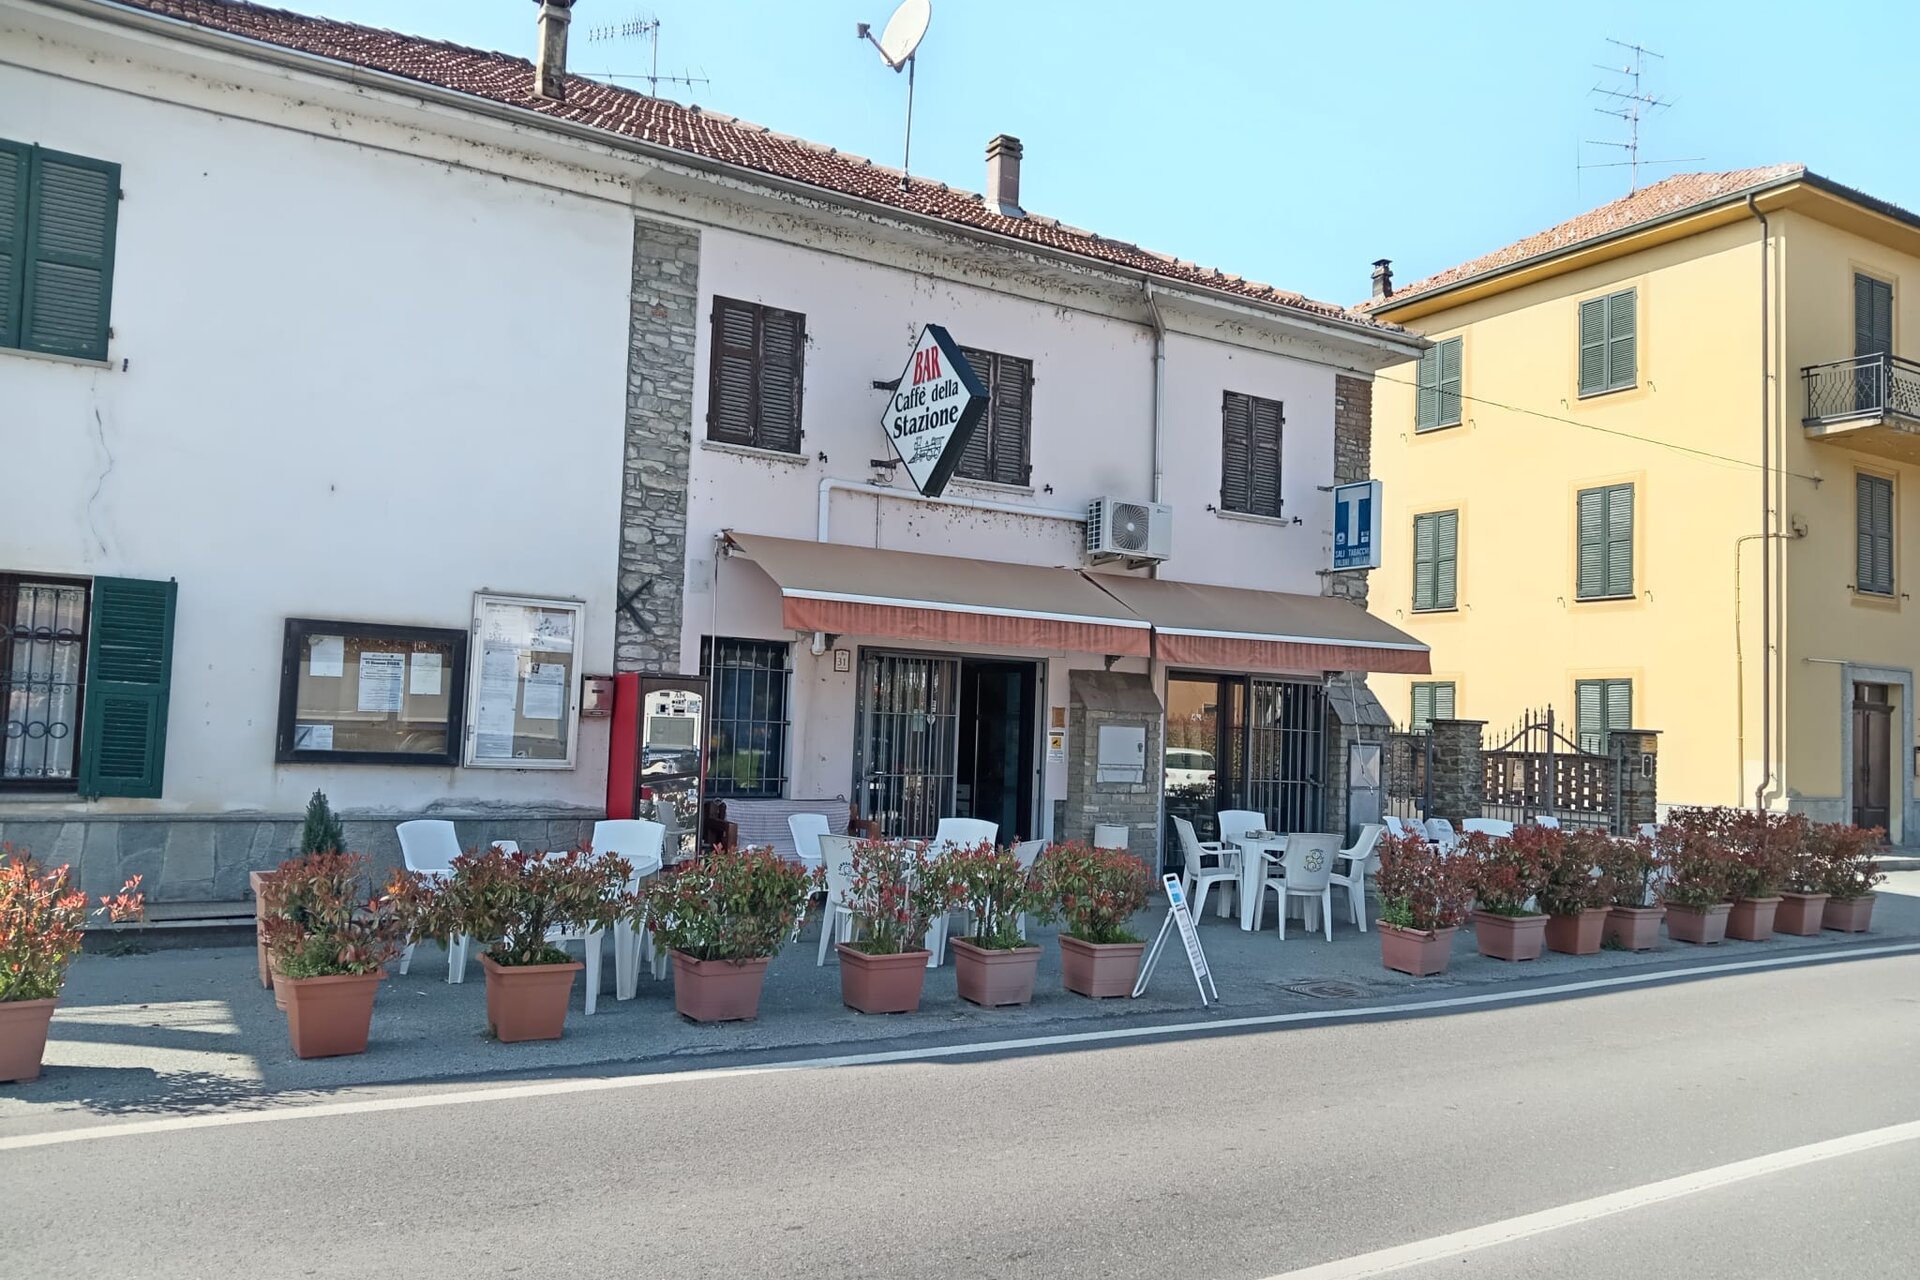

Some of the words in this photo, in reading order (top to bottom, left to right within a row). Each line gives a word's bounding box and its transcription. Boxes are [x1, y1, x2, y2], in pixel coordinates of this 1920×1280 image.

[913, 346, 942, 386] BAR
[895, 386, 926, 413] Caffè
[932, 380, 959, 402] della
[893, 405, 958, 439] Stazione
[1338, 485, 1370, 546] T
[837, 657, 846, 667] 31
